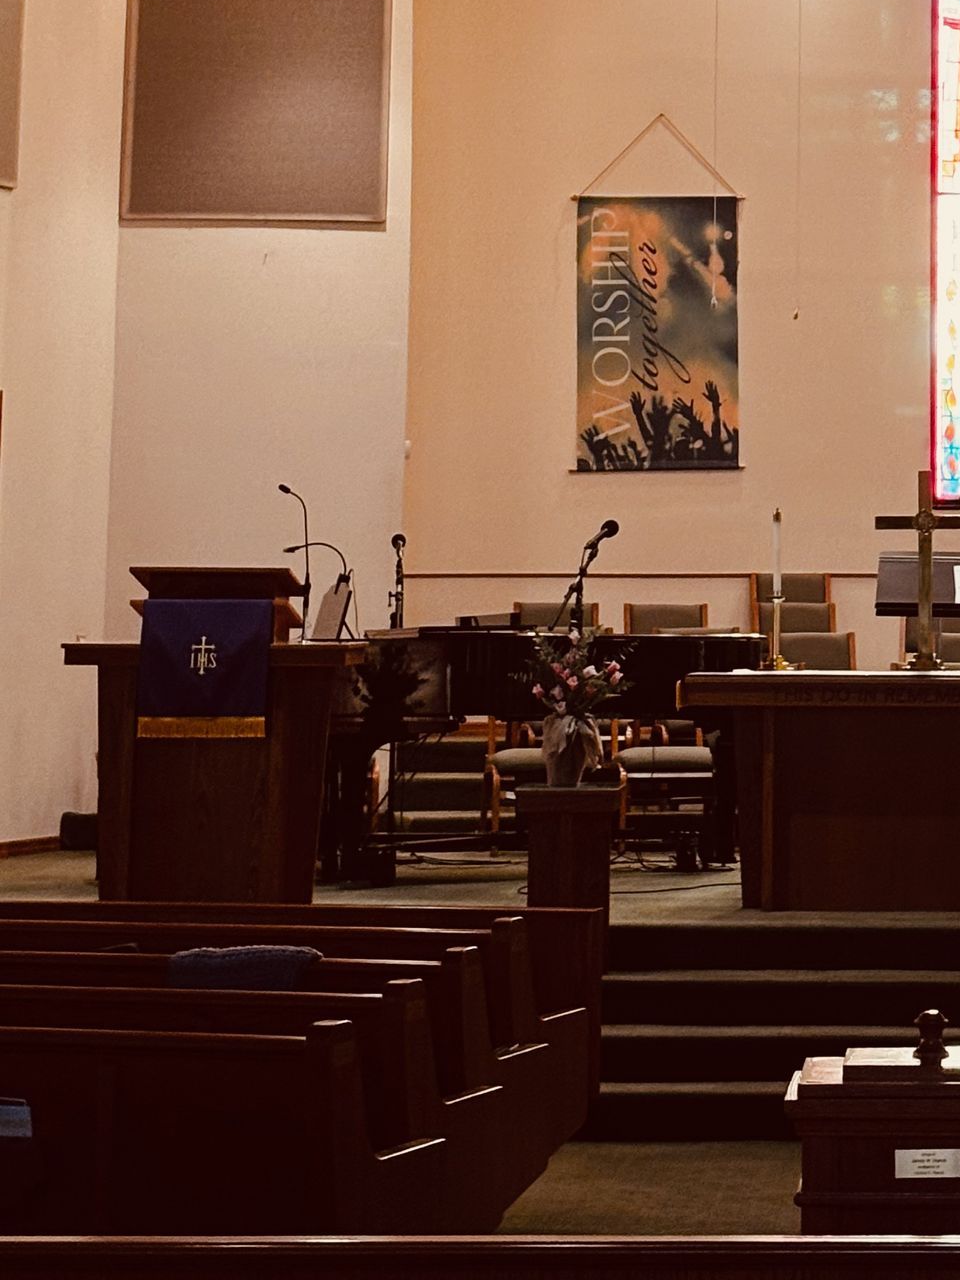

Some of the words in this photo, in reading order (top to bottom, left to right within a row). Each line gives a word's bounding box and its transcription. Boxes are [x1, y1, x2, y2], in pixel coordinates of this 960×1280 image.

[591, 207, 632, 442] WORSHIP
[609, 239, 691, 391] together
[820, 686, 850, 704] DO
